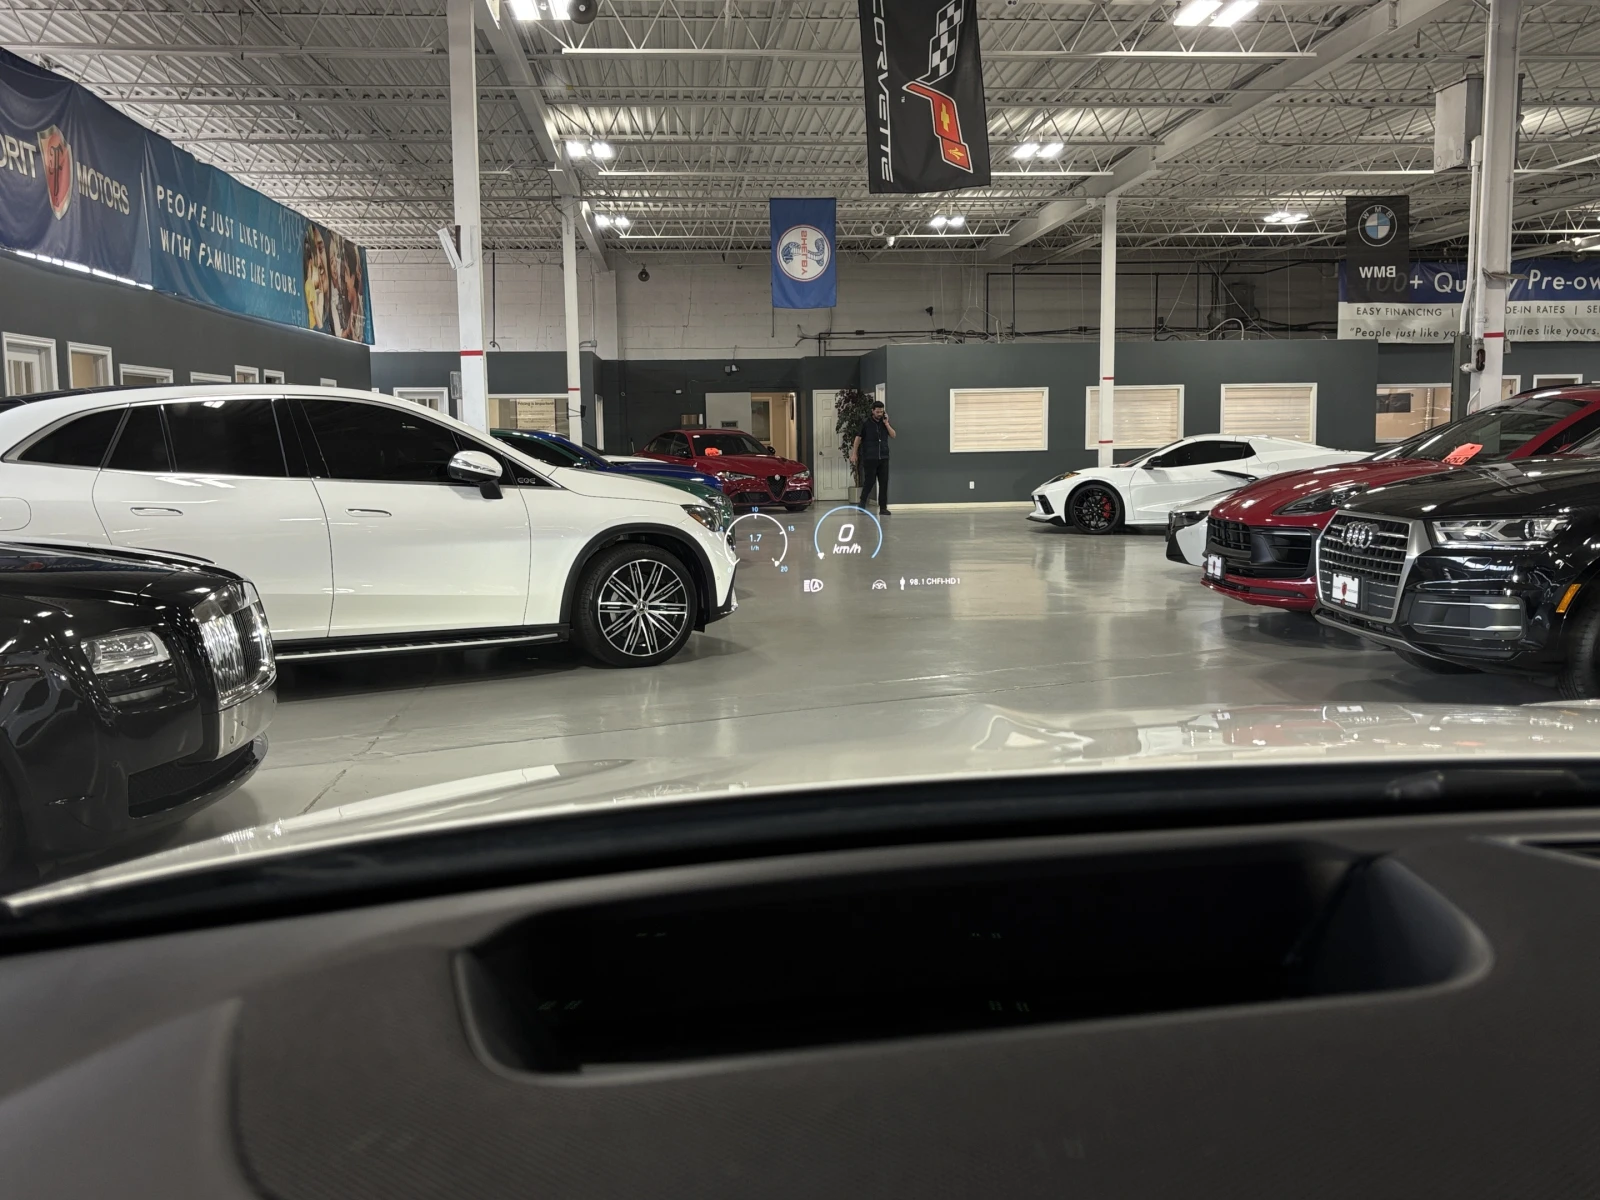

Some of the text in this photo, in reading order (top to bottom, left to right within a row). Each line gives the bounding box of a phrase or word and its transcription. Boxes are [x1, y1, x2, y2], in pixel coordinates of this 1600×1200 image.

[76, 161, 130, 215] MOTORS
[210, 210, 234, 239] JUST
[239, 222, 258, 249] LIKE
[259, 232, 280, 261] YOU,
[160, 226, 301, 297] WITH FAMILIES LIKE YOURS.
[1356, 307, 1382, 316] EASY
[1385, 307, 1442, 317] FINANCING
[1536, 305, 1566, 314] RATES
[1395, 327, 1416, 339] just
[1420, 327, 1440, 337] like
[1543, 325, 1562, 335] like
[749, 533, 762, 543] 1.7
[838, 523, 855, 543] 0
[832, 543, 862, 555] km/h
[780, 565, 789, 573] 20
[909, 578, 925, 586] 98.1
